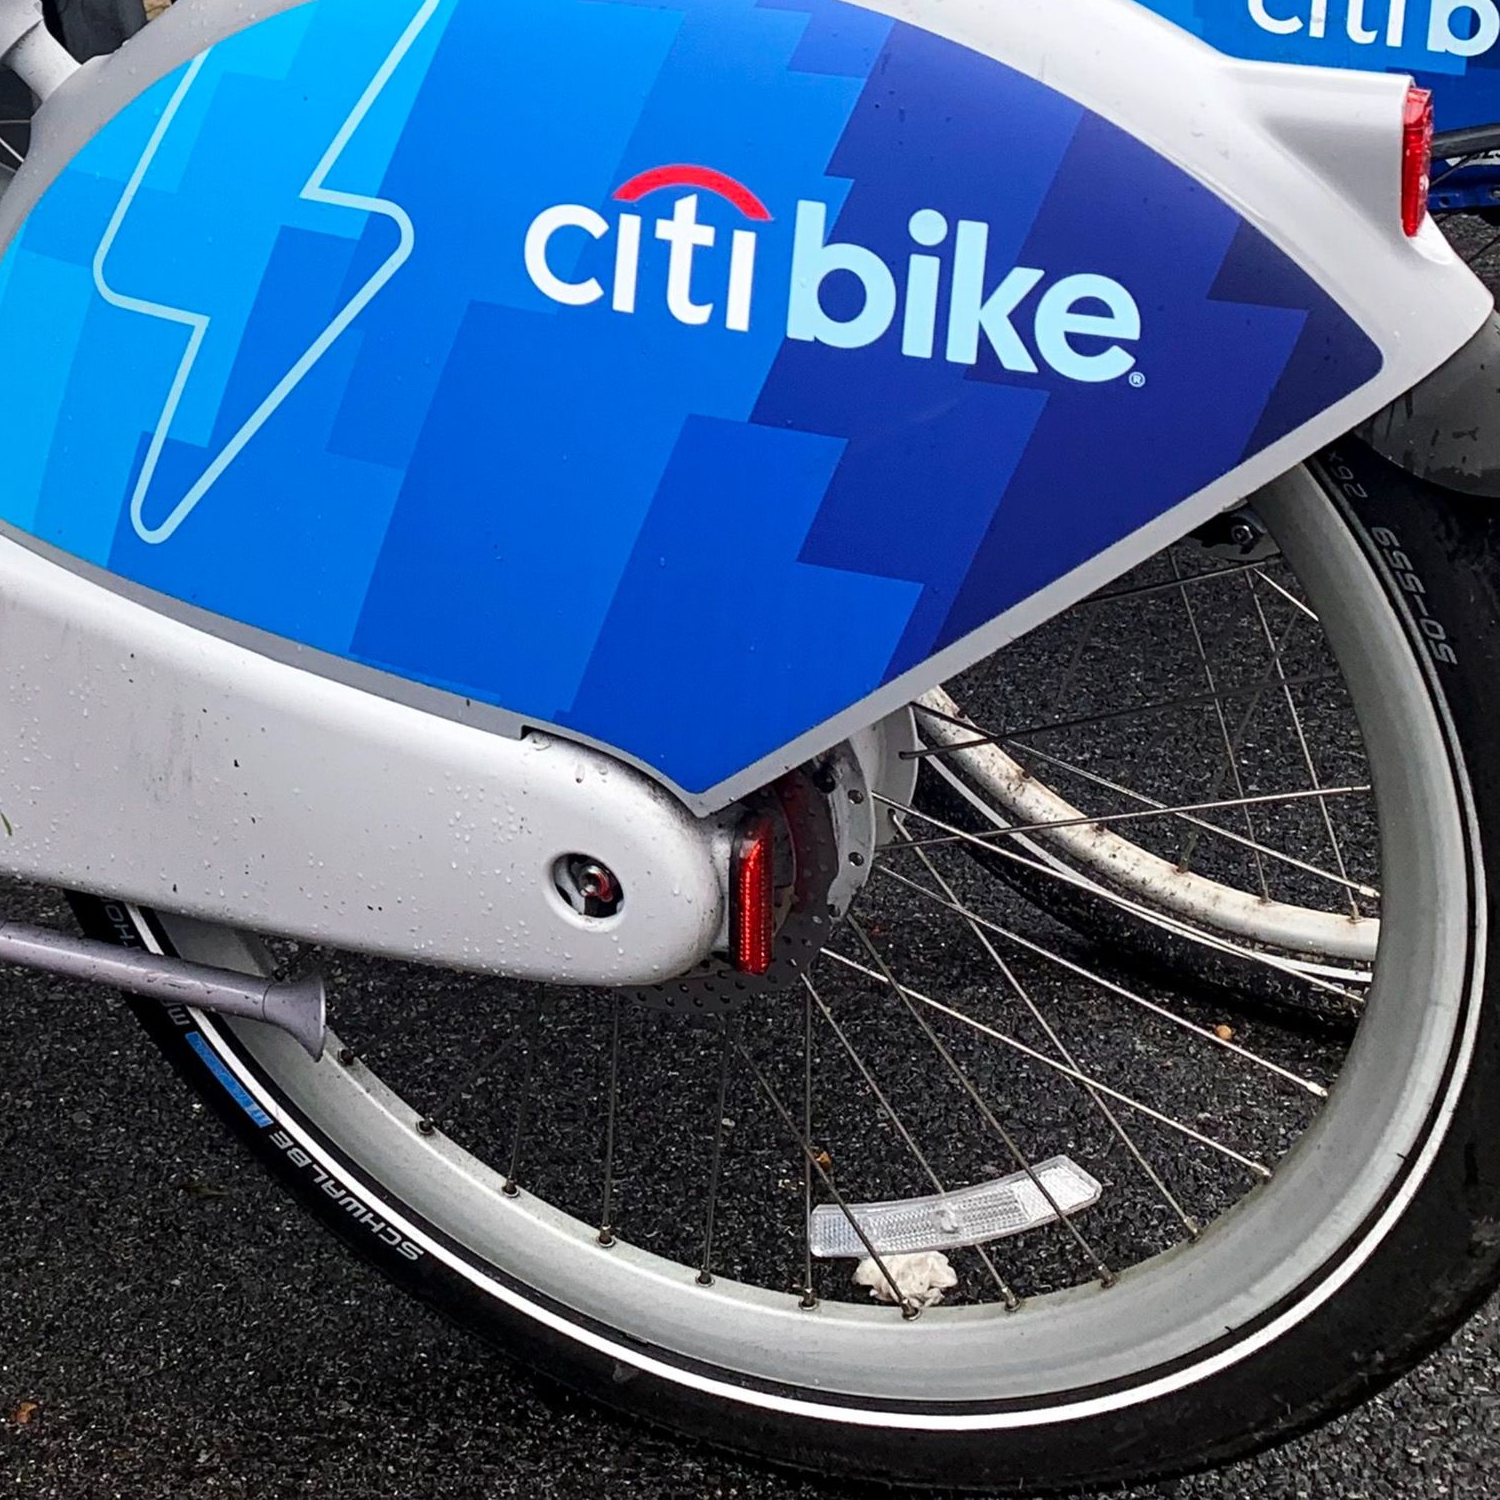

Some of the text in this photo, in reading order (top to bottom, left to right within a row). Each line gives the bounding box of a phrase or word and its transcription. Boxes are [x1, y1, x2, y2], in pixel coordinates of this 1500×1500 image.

[524, 170, 770, 332] citi
[1371, 526, 1459, 665] 50-559
[268, 1129, 425, 1263] SCHWALBE
